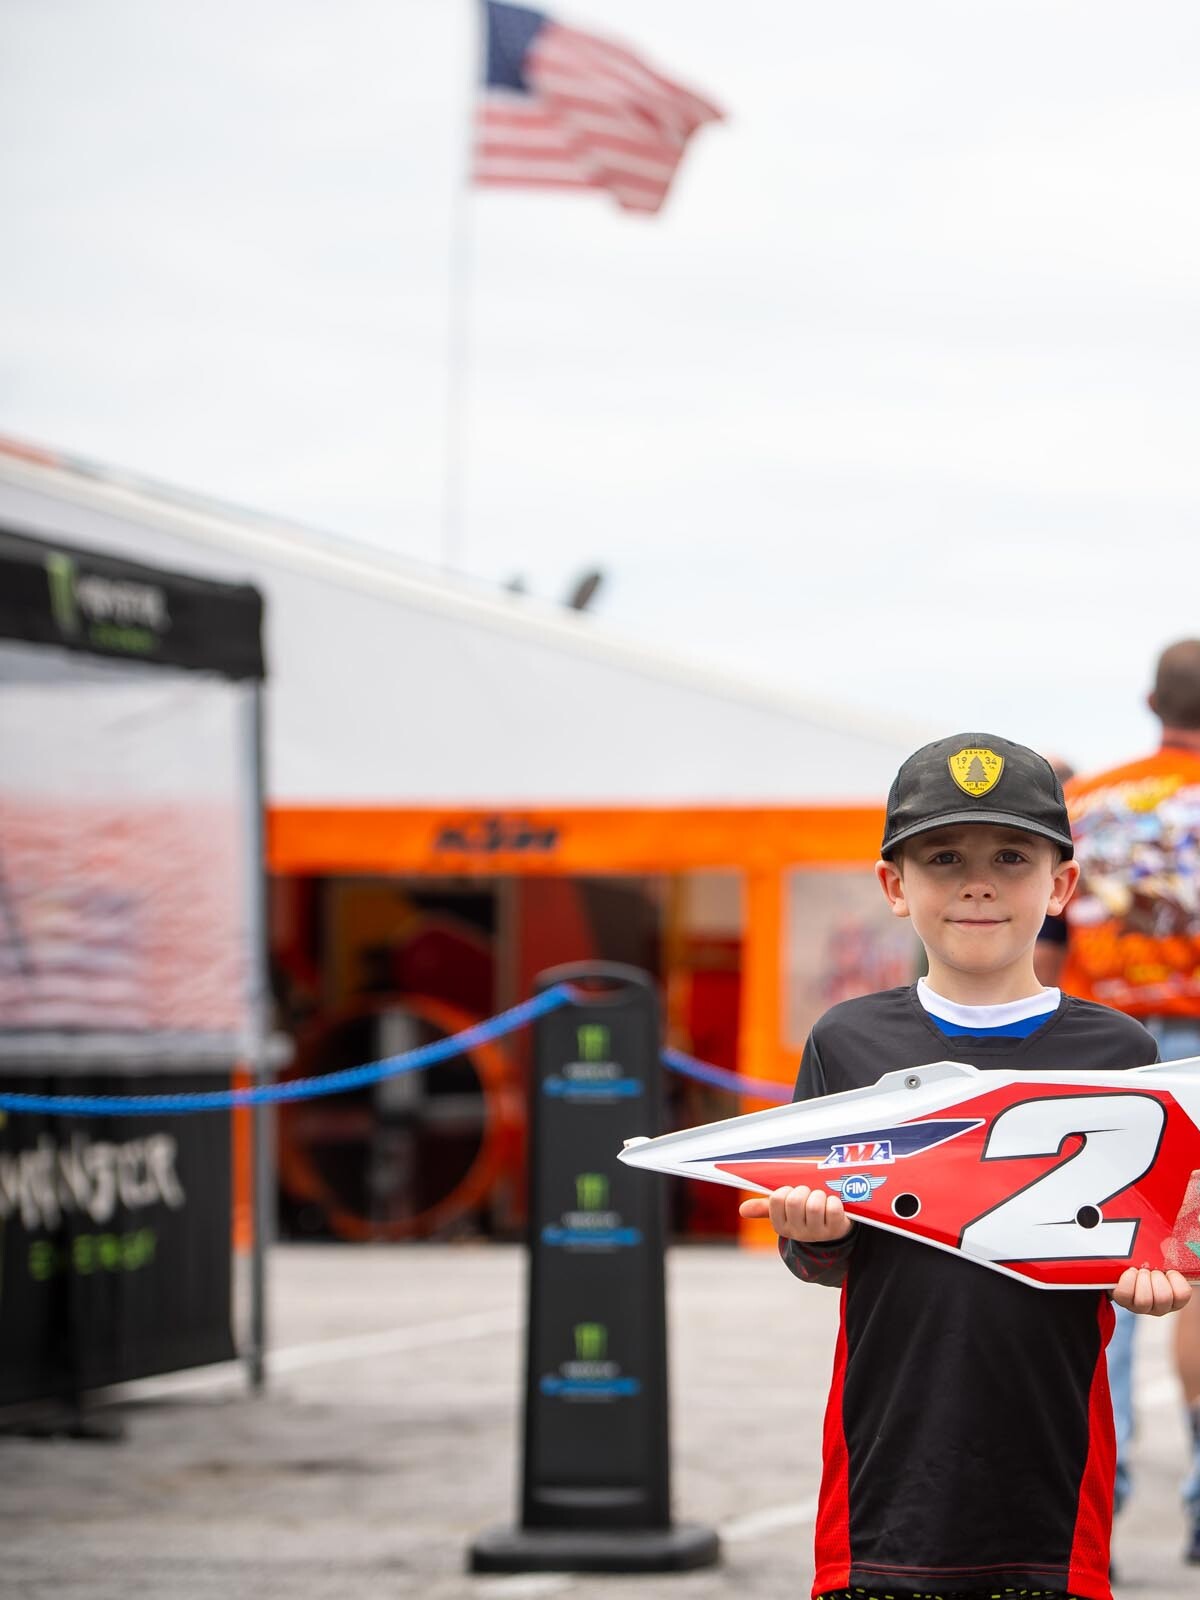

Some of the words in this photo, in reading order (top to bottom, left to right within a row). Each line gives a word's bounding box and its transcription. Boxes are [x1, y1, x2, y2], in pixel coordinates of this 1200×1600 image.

[956, 757, 968, 765] 19
[824, 1142, 890, 1164] AMA
[960, 1092, 1168, 1262] 2
[846, 1181, 867, 1194] FIM
